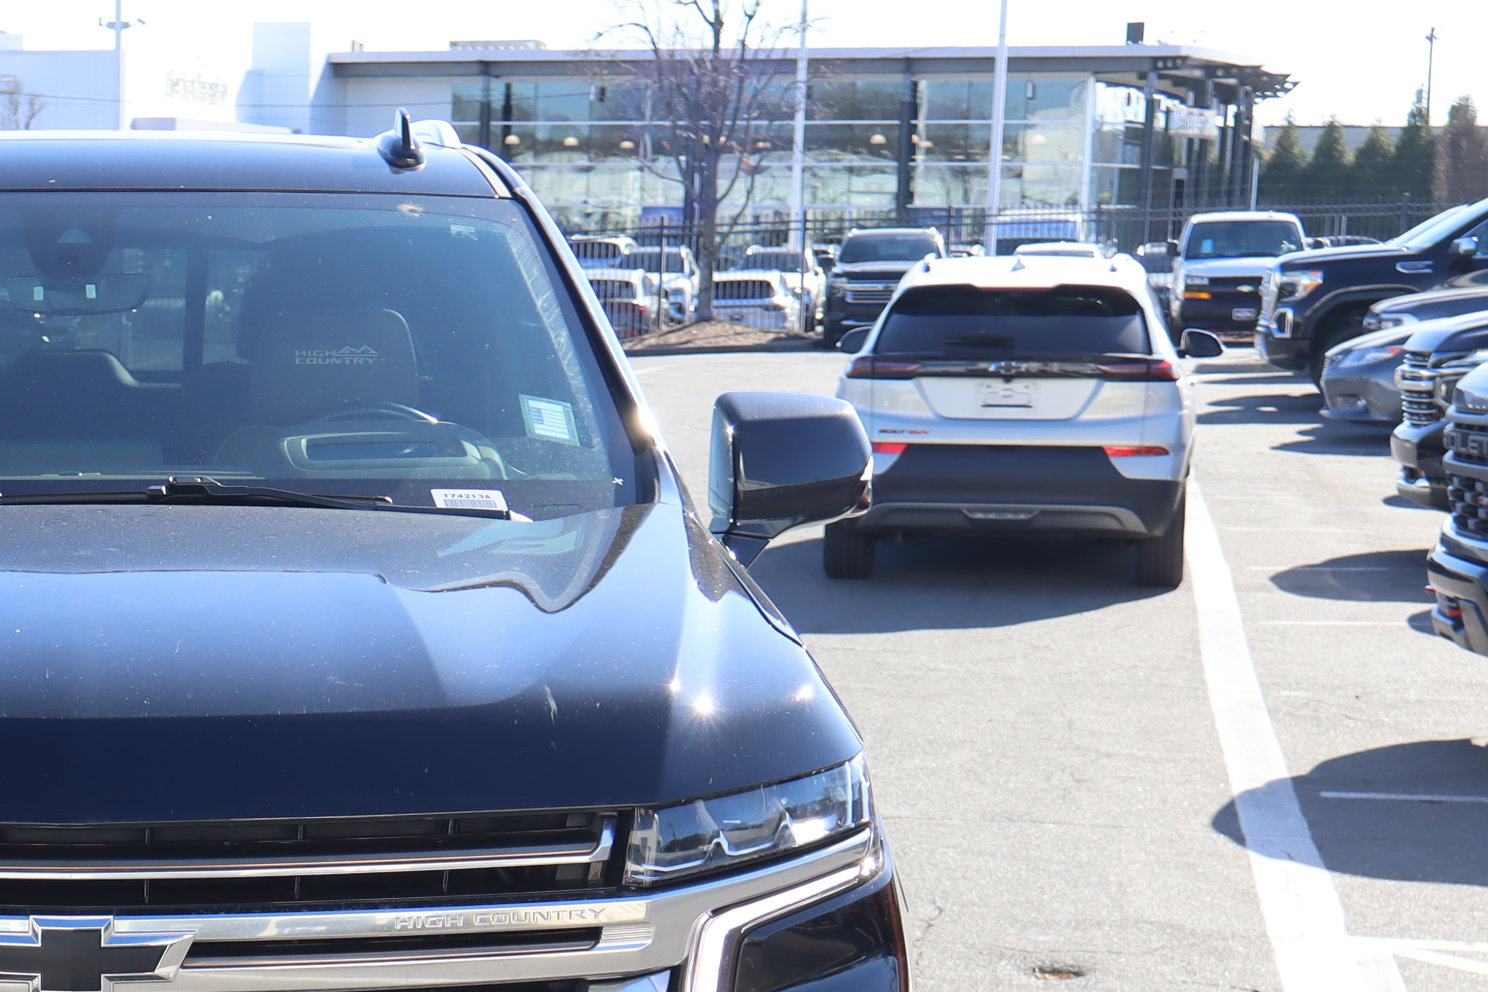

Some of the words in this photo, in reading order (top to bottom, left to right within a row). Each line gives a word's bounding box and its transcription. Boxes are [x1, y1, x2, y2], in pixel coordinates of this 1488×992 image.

[295, 357, 376, 365] COUNTRY
[394, 914, 464, 930] HIGH
[473, 907, 607, 926] COUNTRY
